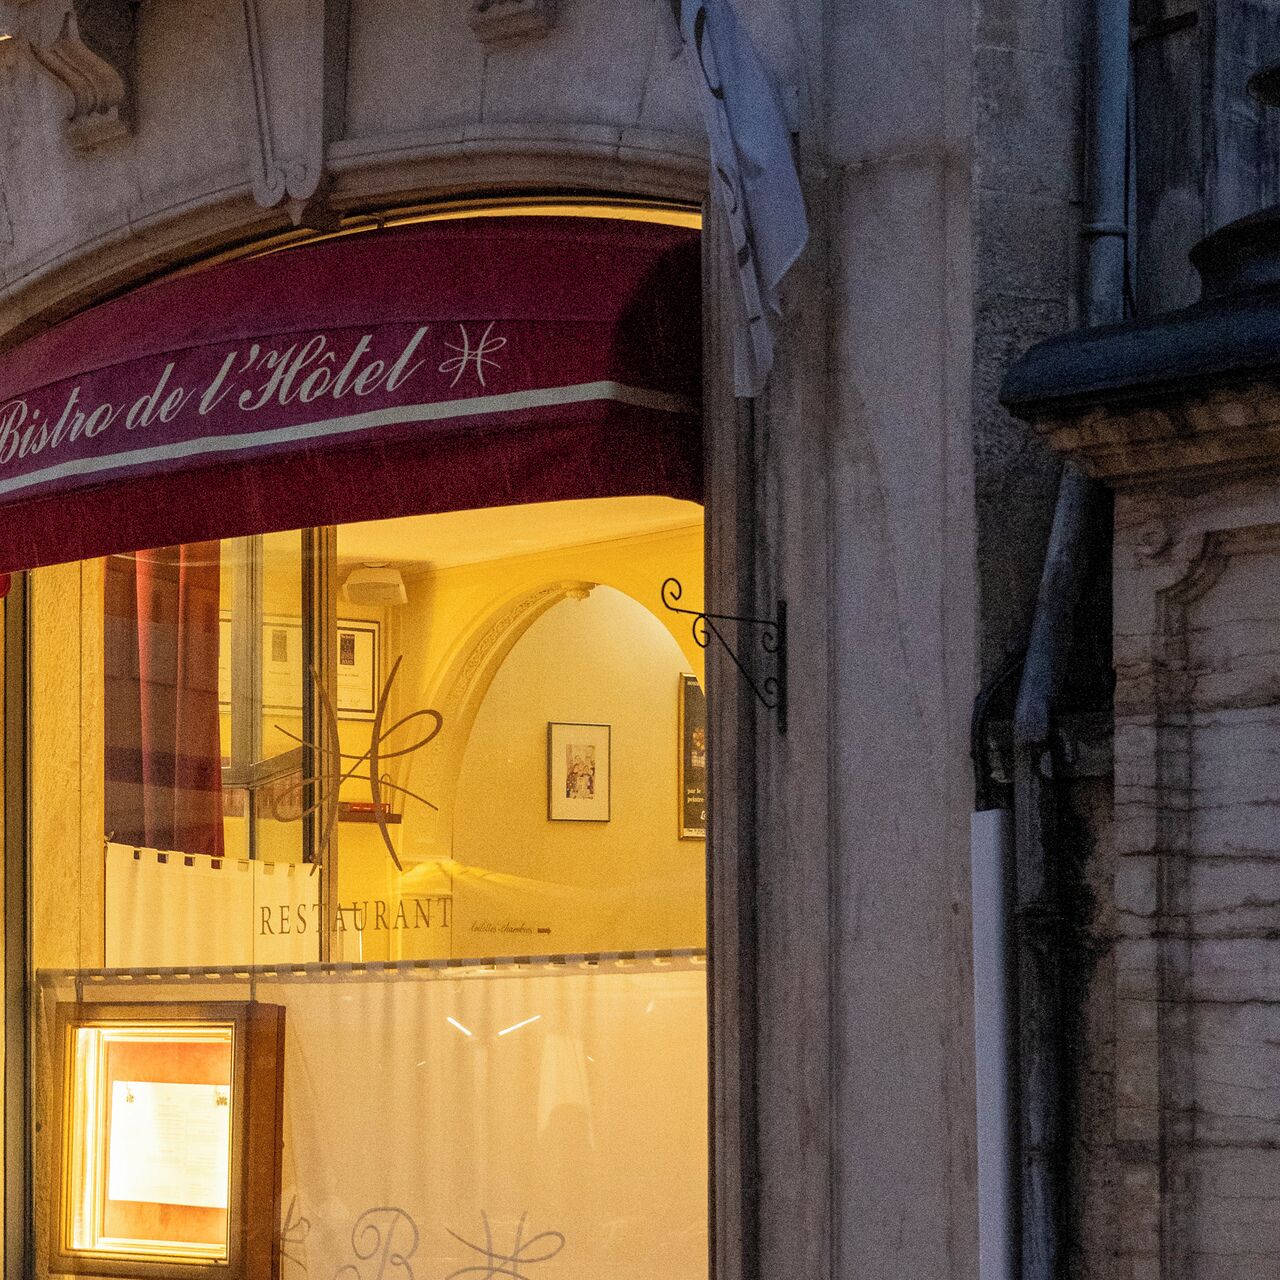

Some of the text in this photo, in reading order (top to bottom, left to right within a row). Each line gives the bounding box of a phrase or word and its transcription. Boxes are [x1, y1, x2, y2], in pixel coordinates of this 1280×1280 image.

[125, 362, 196, 431] de
[198, 326, 429, 416] l'Hôtel
[259, 896, 452, 936] RESTAURANT
